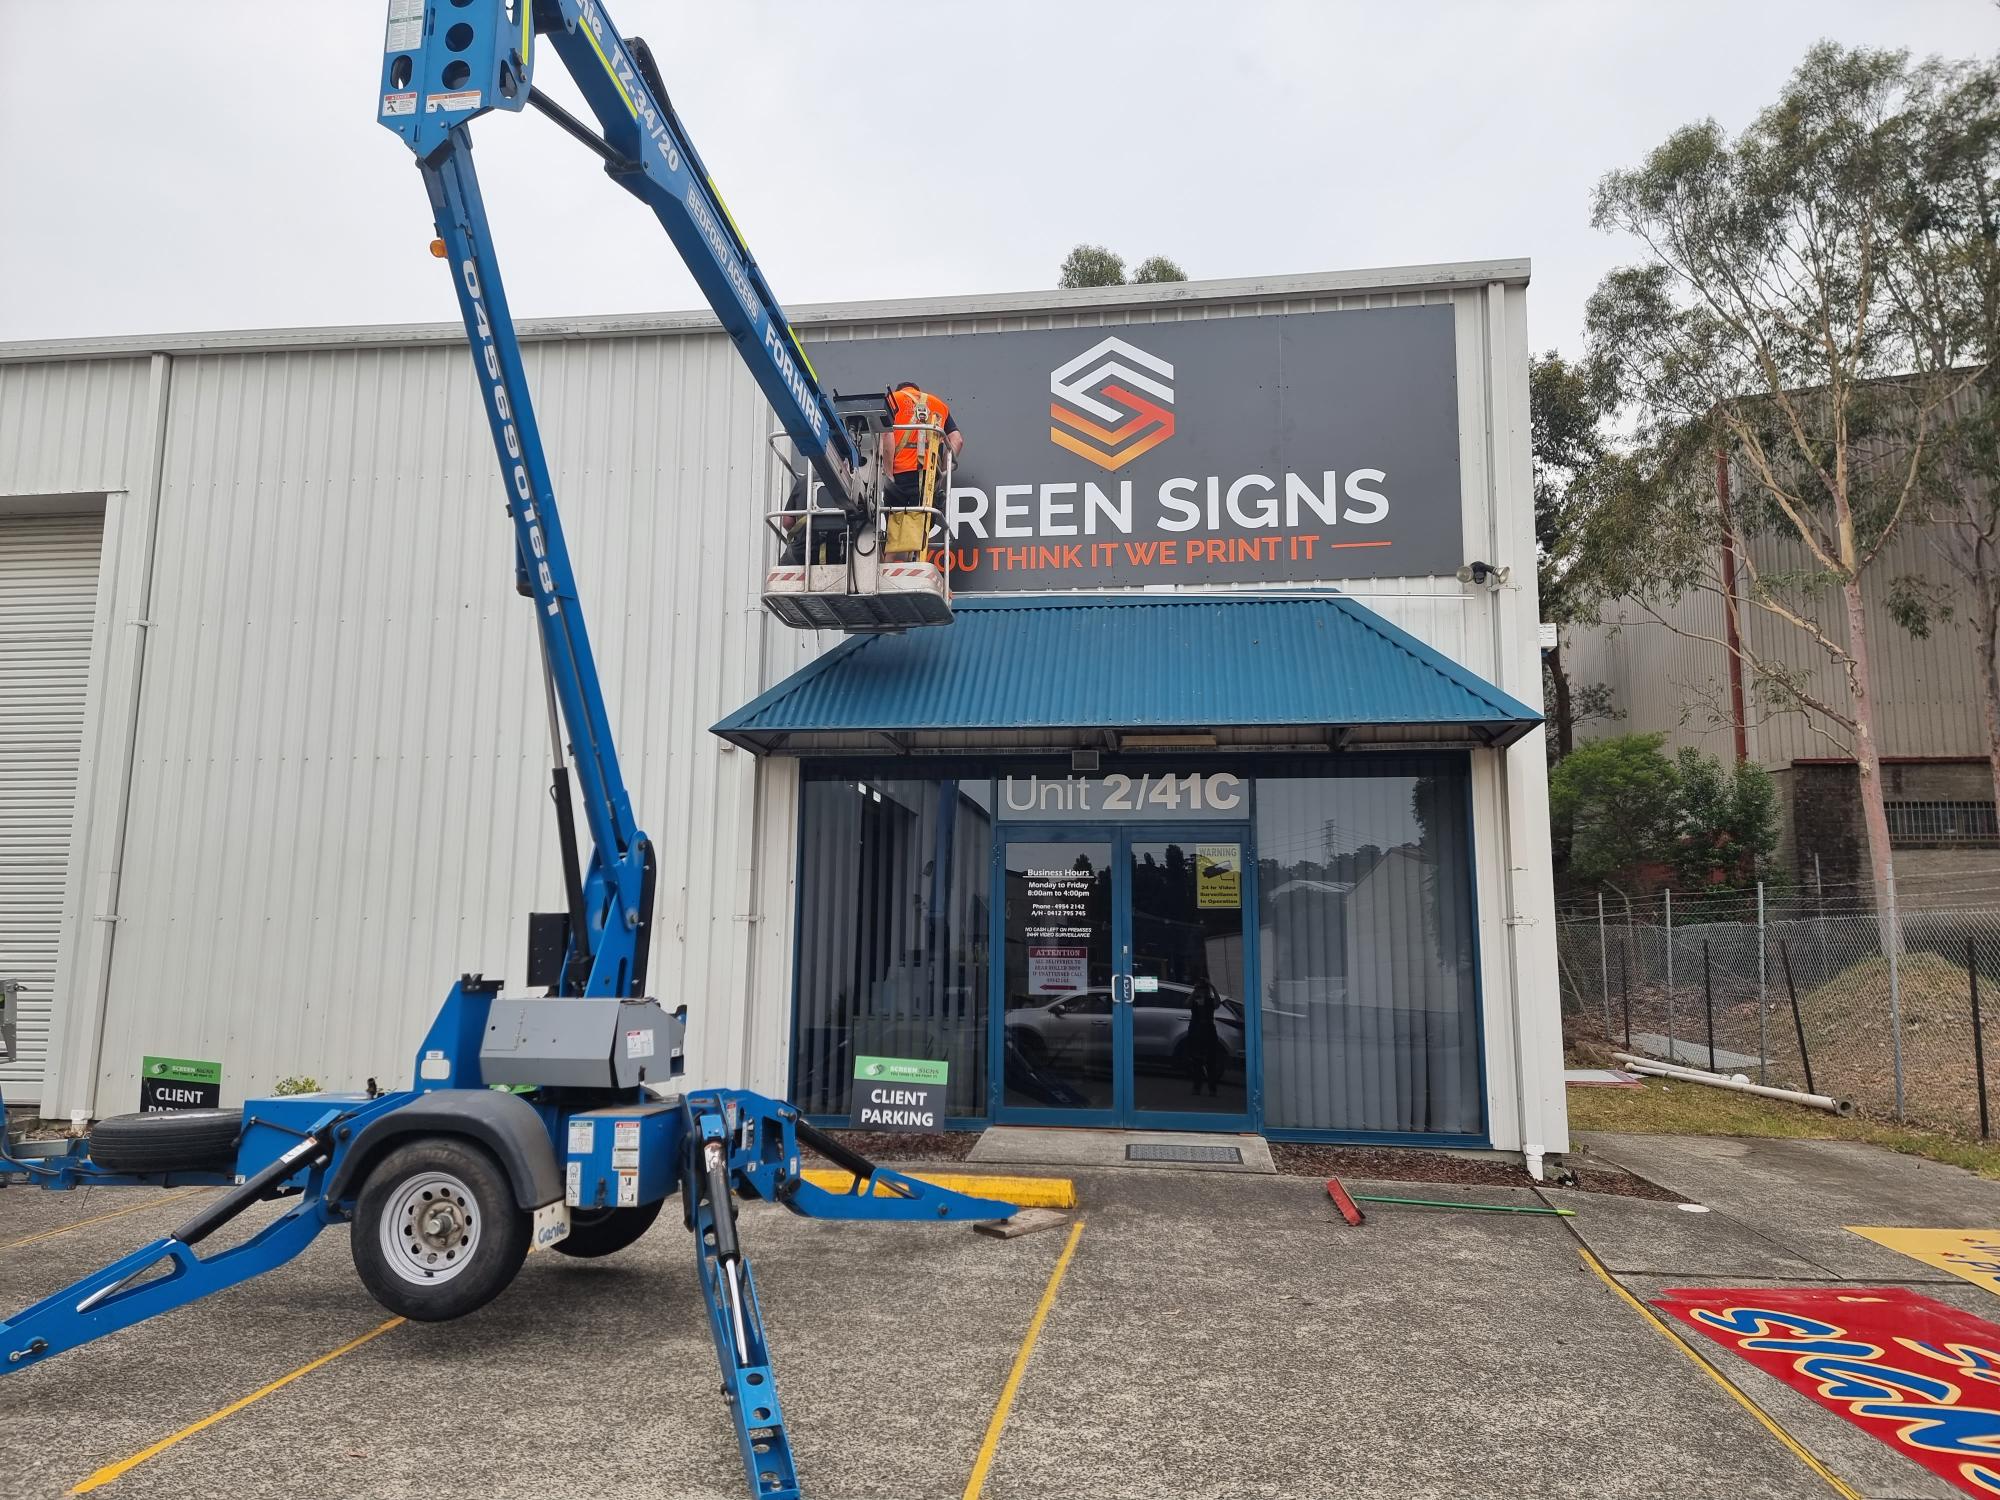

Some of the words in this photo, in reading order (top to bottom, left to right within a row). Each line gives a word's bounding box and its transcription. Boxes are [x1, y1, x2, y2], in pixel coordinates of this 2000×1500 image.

[611, 44, 679, 171] TZ-34/20
[688, 189, 728, 265] BEDFORD
[727, 259, 758, 318] ACCESS
[765, 323, 795, 386] FOR
[792, 376, 822, 437] HIRE
[463, 260, 559, 616] 0456901681
[1156, 468, 1390, 532] SIGNS
[986, 544, 1084, 571] THINK
[1091, 543, 1119, 567] IT
[1125, 541, 1177, 566] WE
[1187, 536, 1281, 564] PRINT
[1290, 535, 1319, 560] IT
[1006, 774, 1091, 811] Unit
[1102, 772, 1241, 811] 2/41C
[1199, 847, 1237, 857] WARNING
[1027, 889, 1053, 897] 8:00am
[1063, 889, 1090, 898] 4:00pm
[1029, 881, 1057, 889] Monday
[1066, 881, 1089, 890] Friday
[1035, 949, 1080, 957] ATTENTION
[156, 1087, 204, 1104] CLIENT
[870, 1089, 928, 1106] CLIENT
[861, 1108, 934, 1127] PARKING
[538, 1221, 567, 1244] Genie
